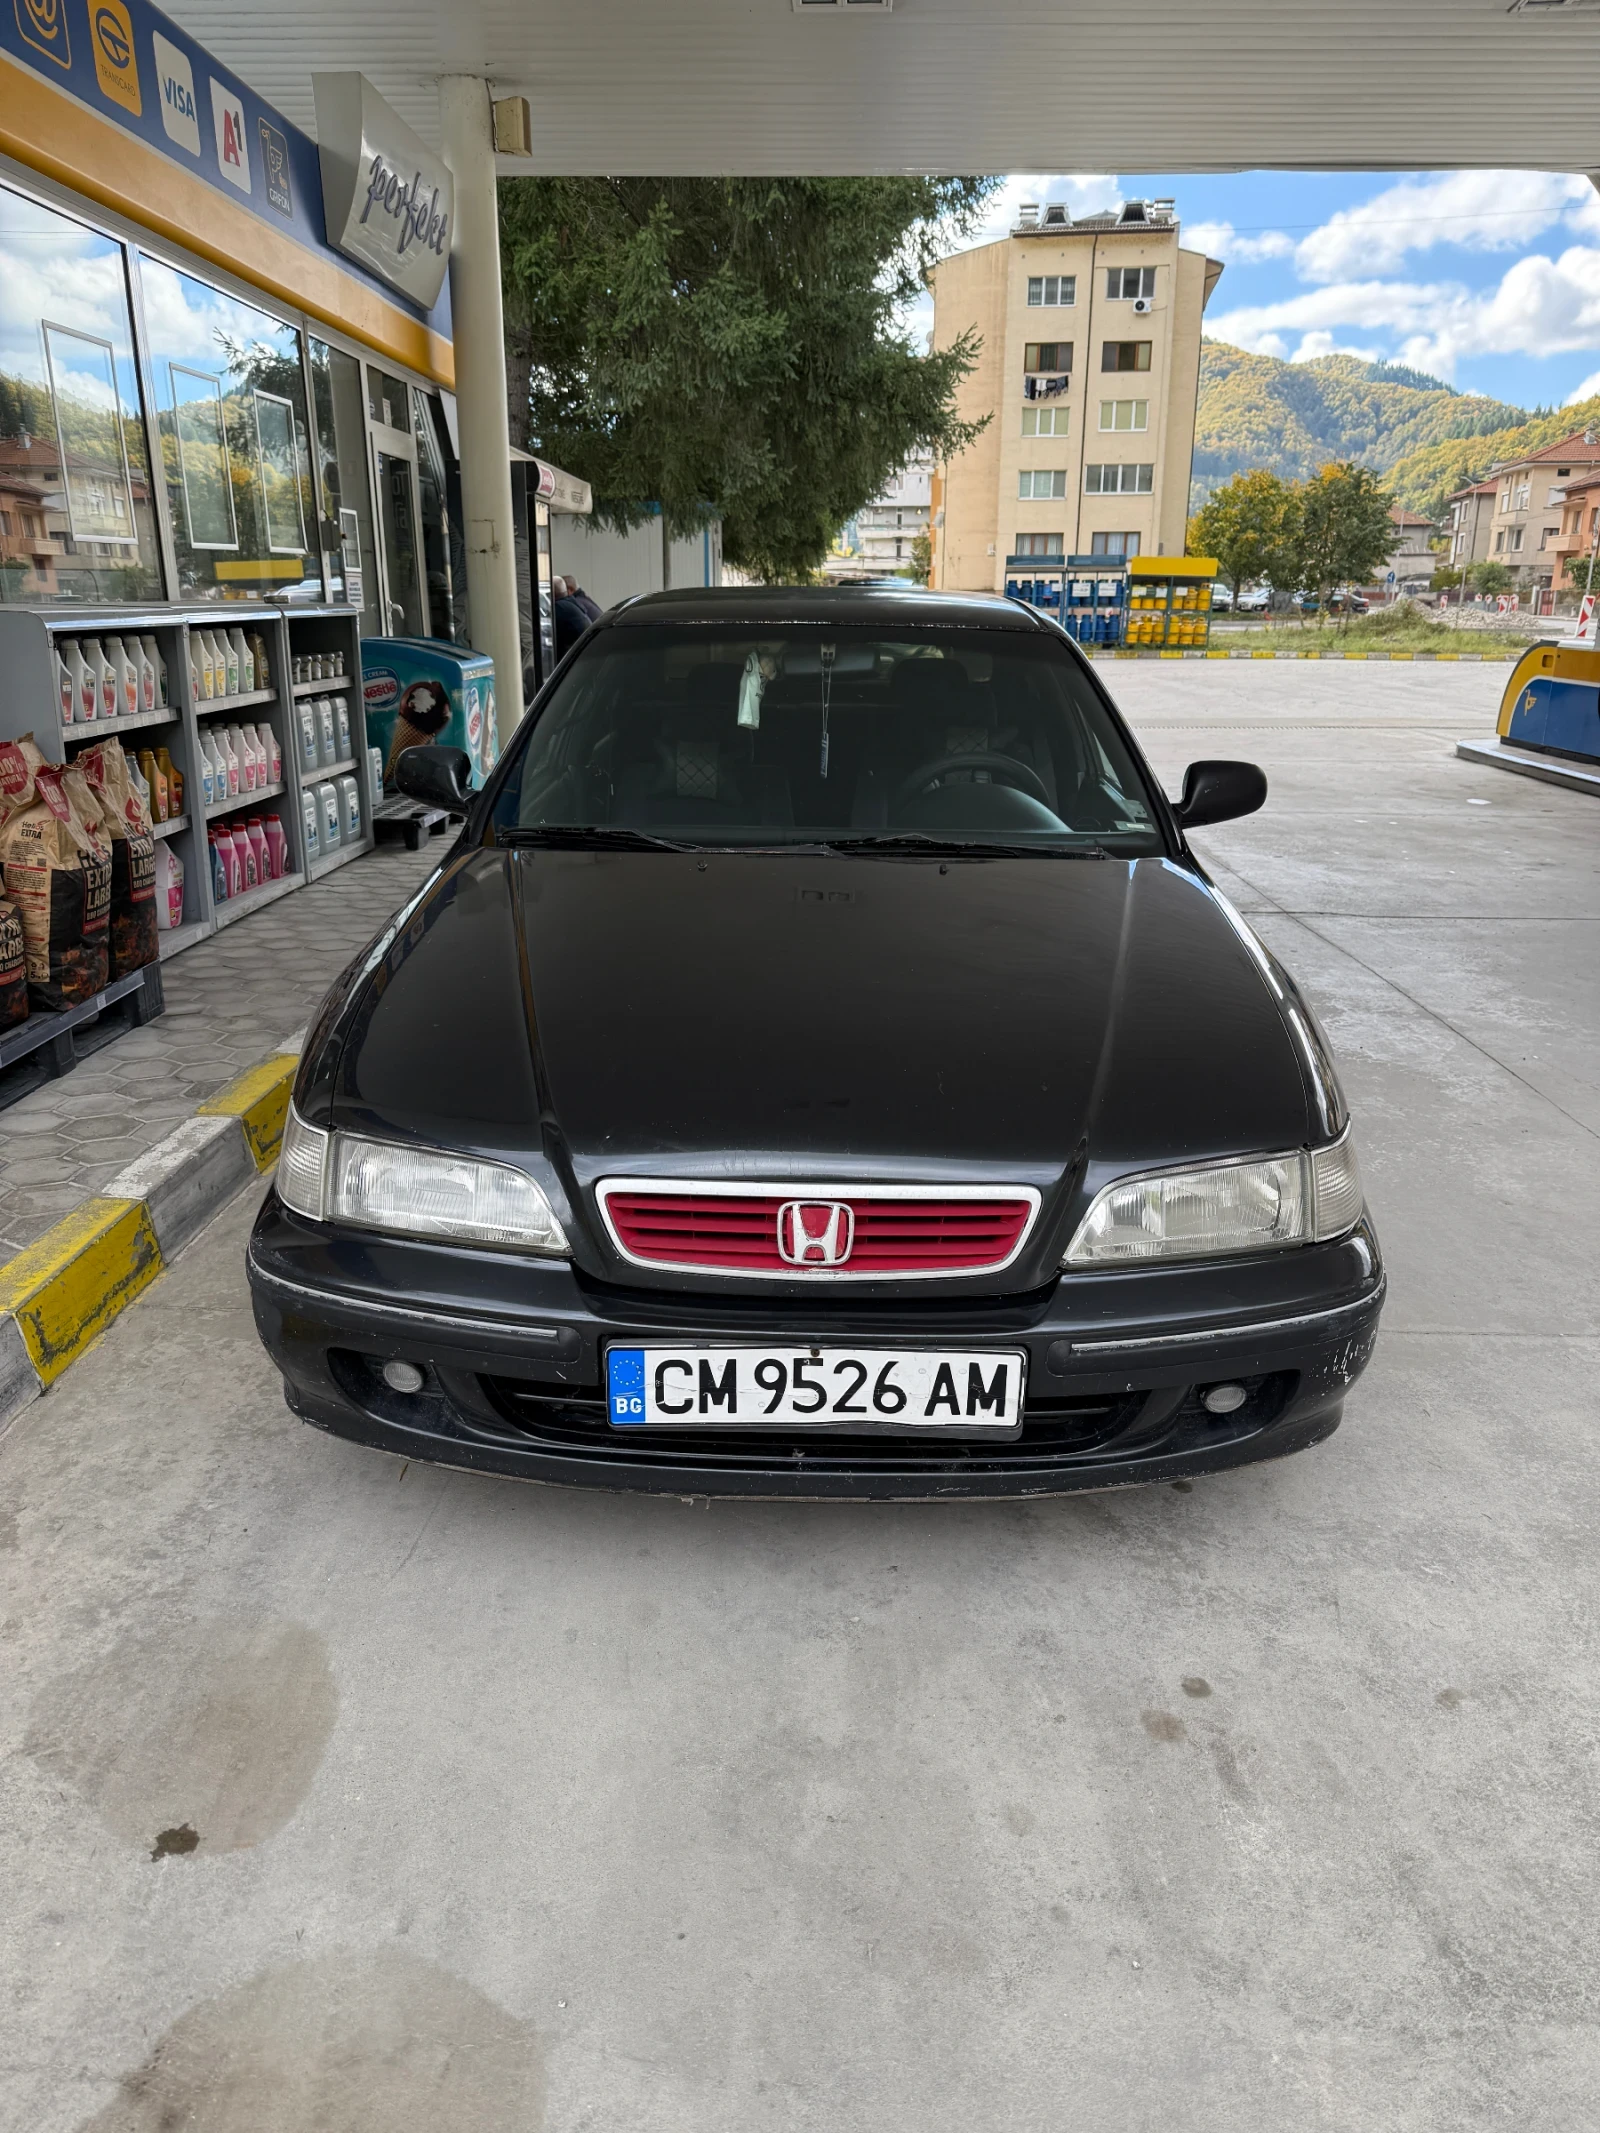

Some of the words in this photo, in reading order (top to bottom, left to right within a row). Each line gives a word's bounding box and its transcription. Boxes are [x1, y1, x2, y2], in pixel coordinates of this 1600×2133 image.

[101, 64, 136, 97] TRANSCARD
[162, 72, 196, 123] VISA
[223, 109, 243, 168] A1
[359, 154, 448, 256] perfekt
[20, 829, 42, 840] EXTRA
[616, 1397, 642, 1414] BG
[654, 1358, 738, 1415] CM
[753, 1357, 909, 1415] 9526
[924, 1361, 1009, 1418] AM
